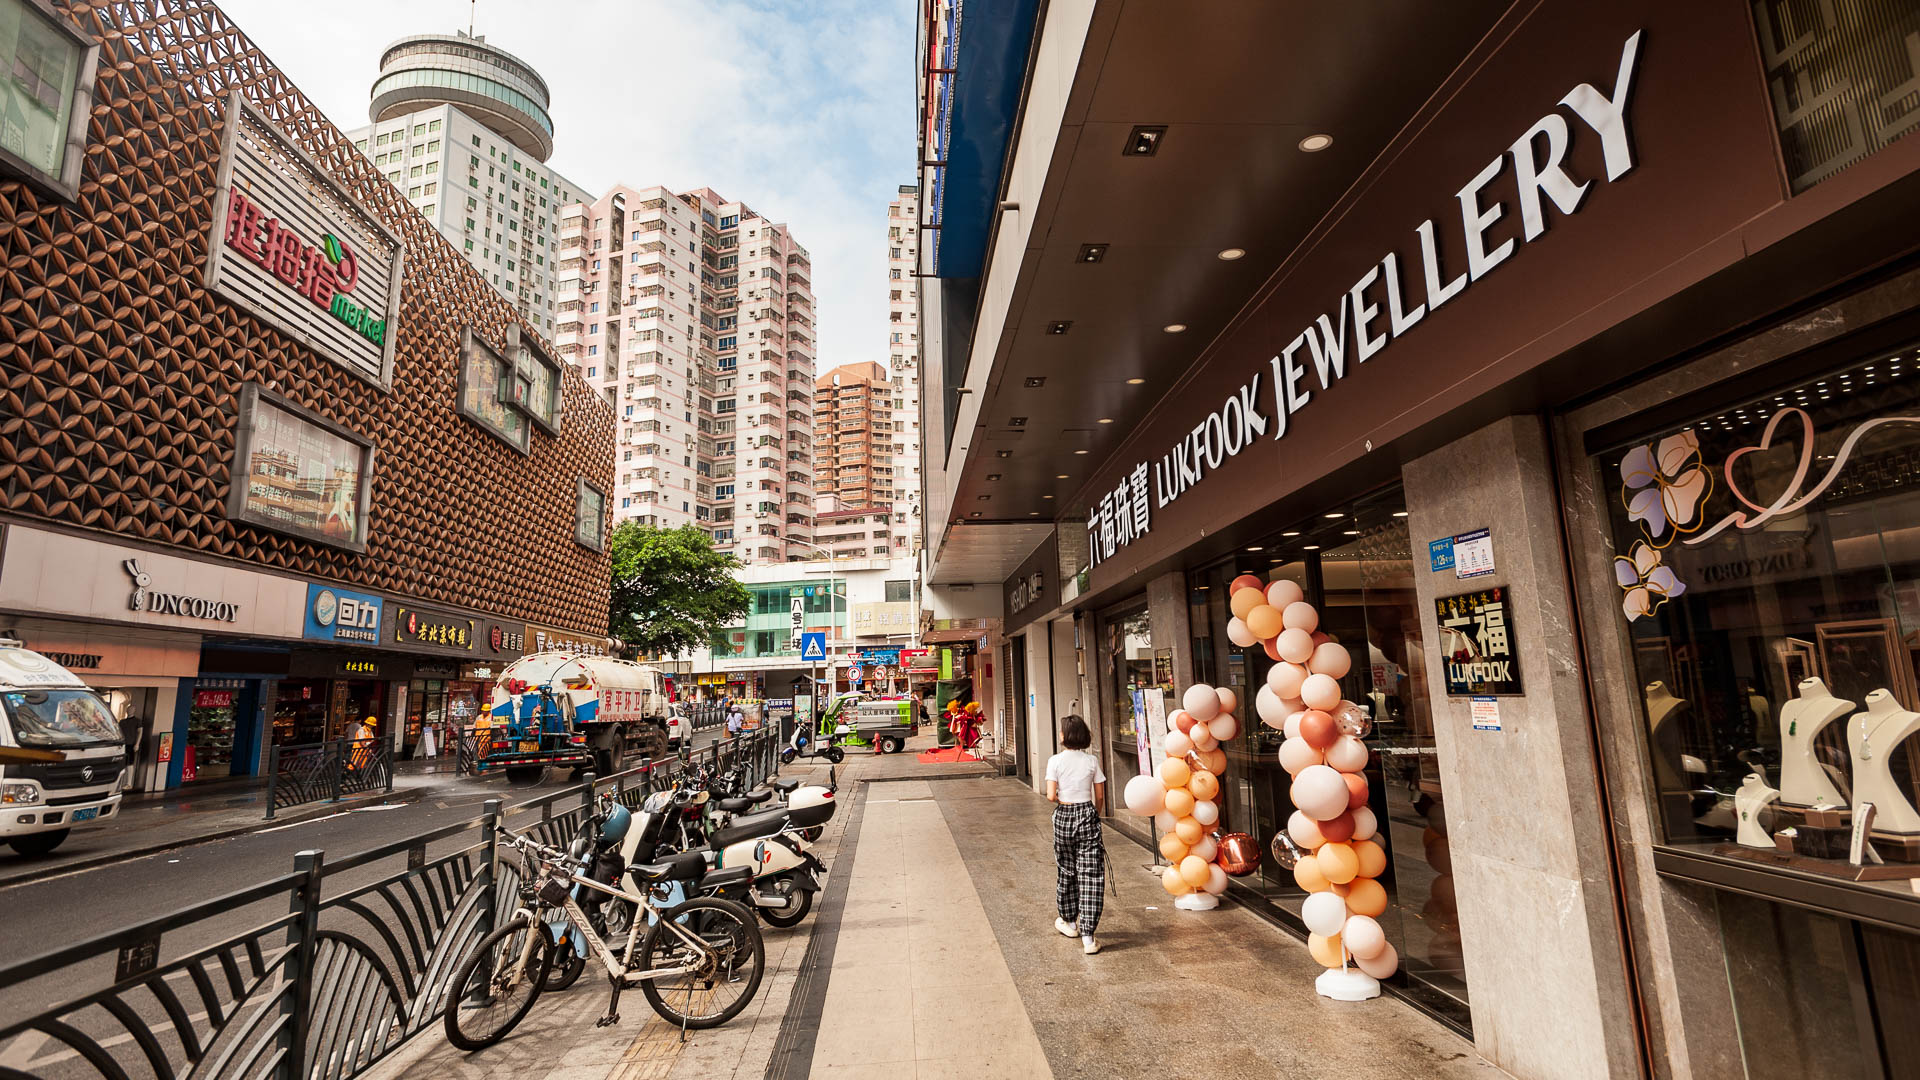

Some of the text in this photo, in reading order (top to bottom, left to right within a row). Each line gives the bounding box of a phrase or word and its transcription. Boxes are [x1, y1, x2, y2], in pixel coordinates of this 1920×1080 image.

[1155, 28, 1642, 509] LUKFOOK JEWELLERY
[330, 293, 385, 346] market
[1087, 461, 1150, 570] 六福珠寶
[149, 592, 240, 622] DNCOBOY
[337, 597, 378, 629] 回力
[417, 622, 466, 646] 老北京布鞋
[792, 599, 802, 650] 八号广场
[1444, 602, 1509, 657] 六福
[36, 651, 102, 669] COBOY
[1449, 661, 1512, 683] LUKFOOK
[604, 689, 641, 713] 常平环卫
